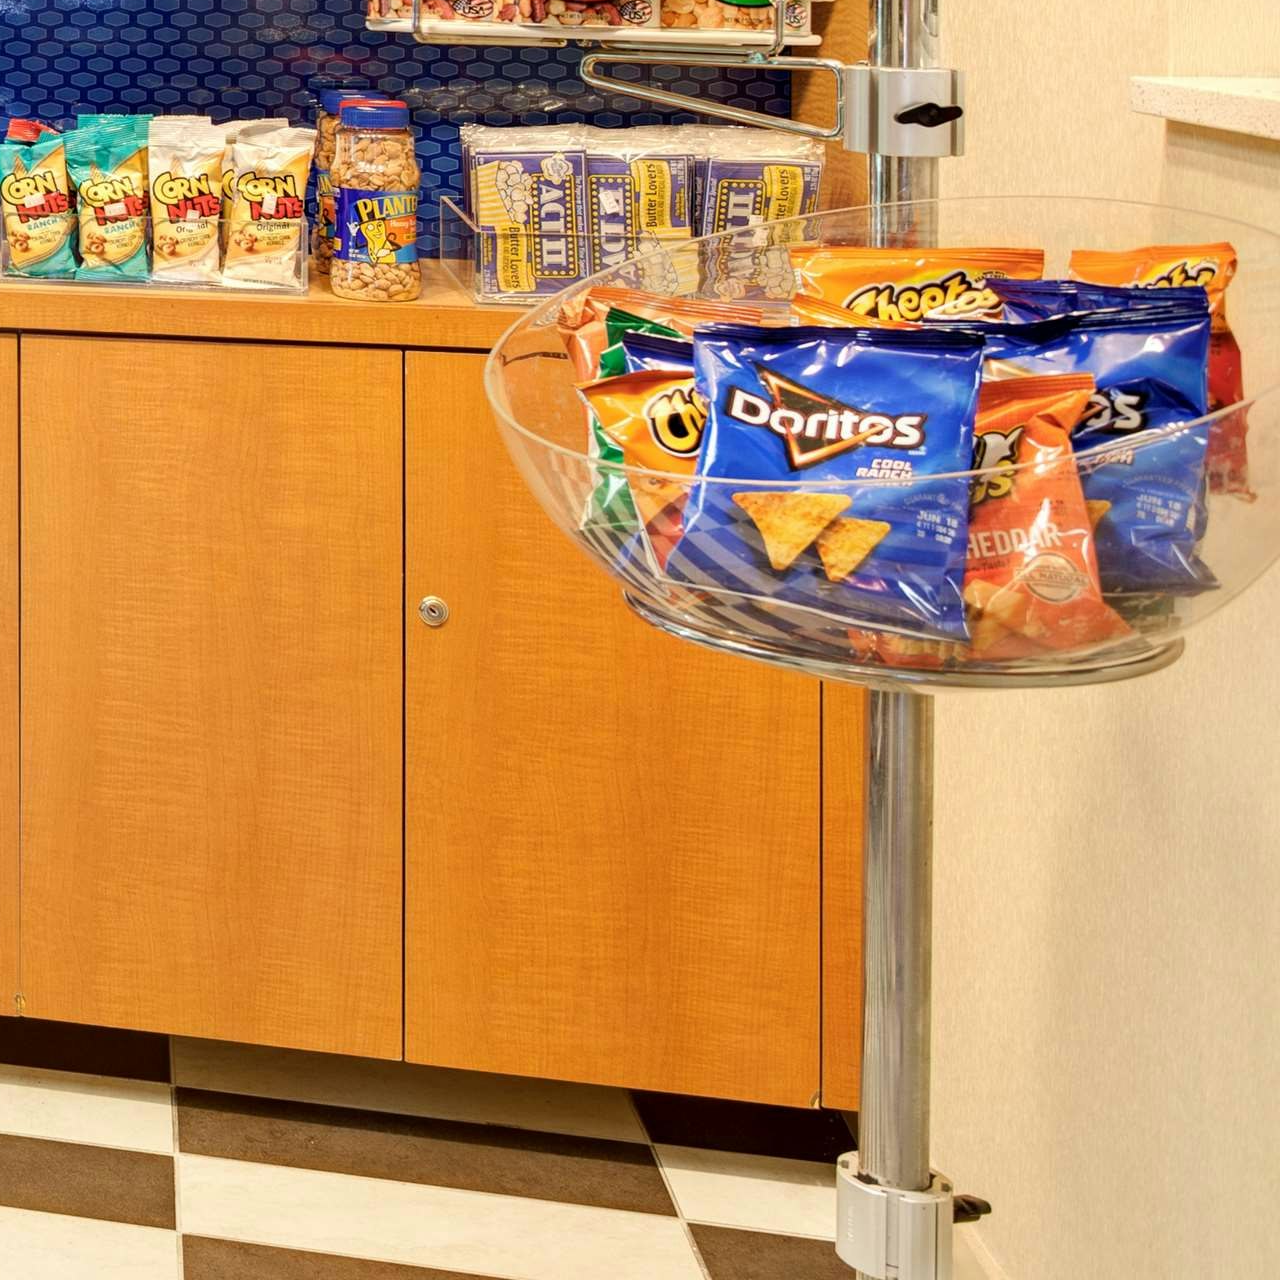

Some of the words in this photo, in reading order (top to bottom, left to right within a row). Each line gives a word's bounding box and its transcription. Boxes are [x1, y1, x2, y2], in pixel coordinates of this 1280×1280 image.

[461, 6, 486, 15] USA
[628, 10, 647, 20] USA
[0, 171, 59, 206] CORN
[79, 176, 140, 208] CORN
[153, 172, 211, 205] CORN
[238, 171, 297, 204] CORN
[645, 162, 658, 199] Lovers
[27, 217, 59, 231] RANCH
[104, 220, 138, 234] RANCH
[256, 221, 290, 233] Original
[645, 200, 657, 228] Butter
[511, 226, 521, 259] Butter
[510, 261, 521, 291] Lovers
[729, 388, 924, 447] Doritos
[856, 467, 914, 480] RANCH
[872, 458, 913, 470] COOL
[966, 523, 1062, 559] HEDDAR
